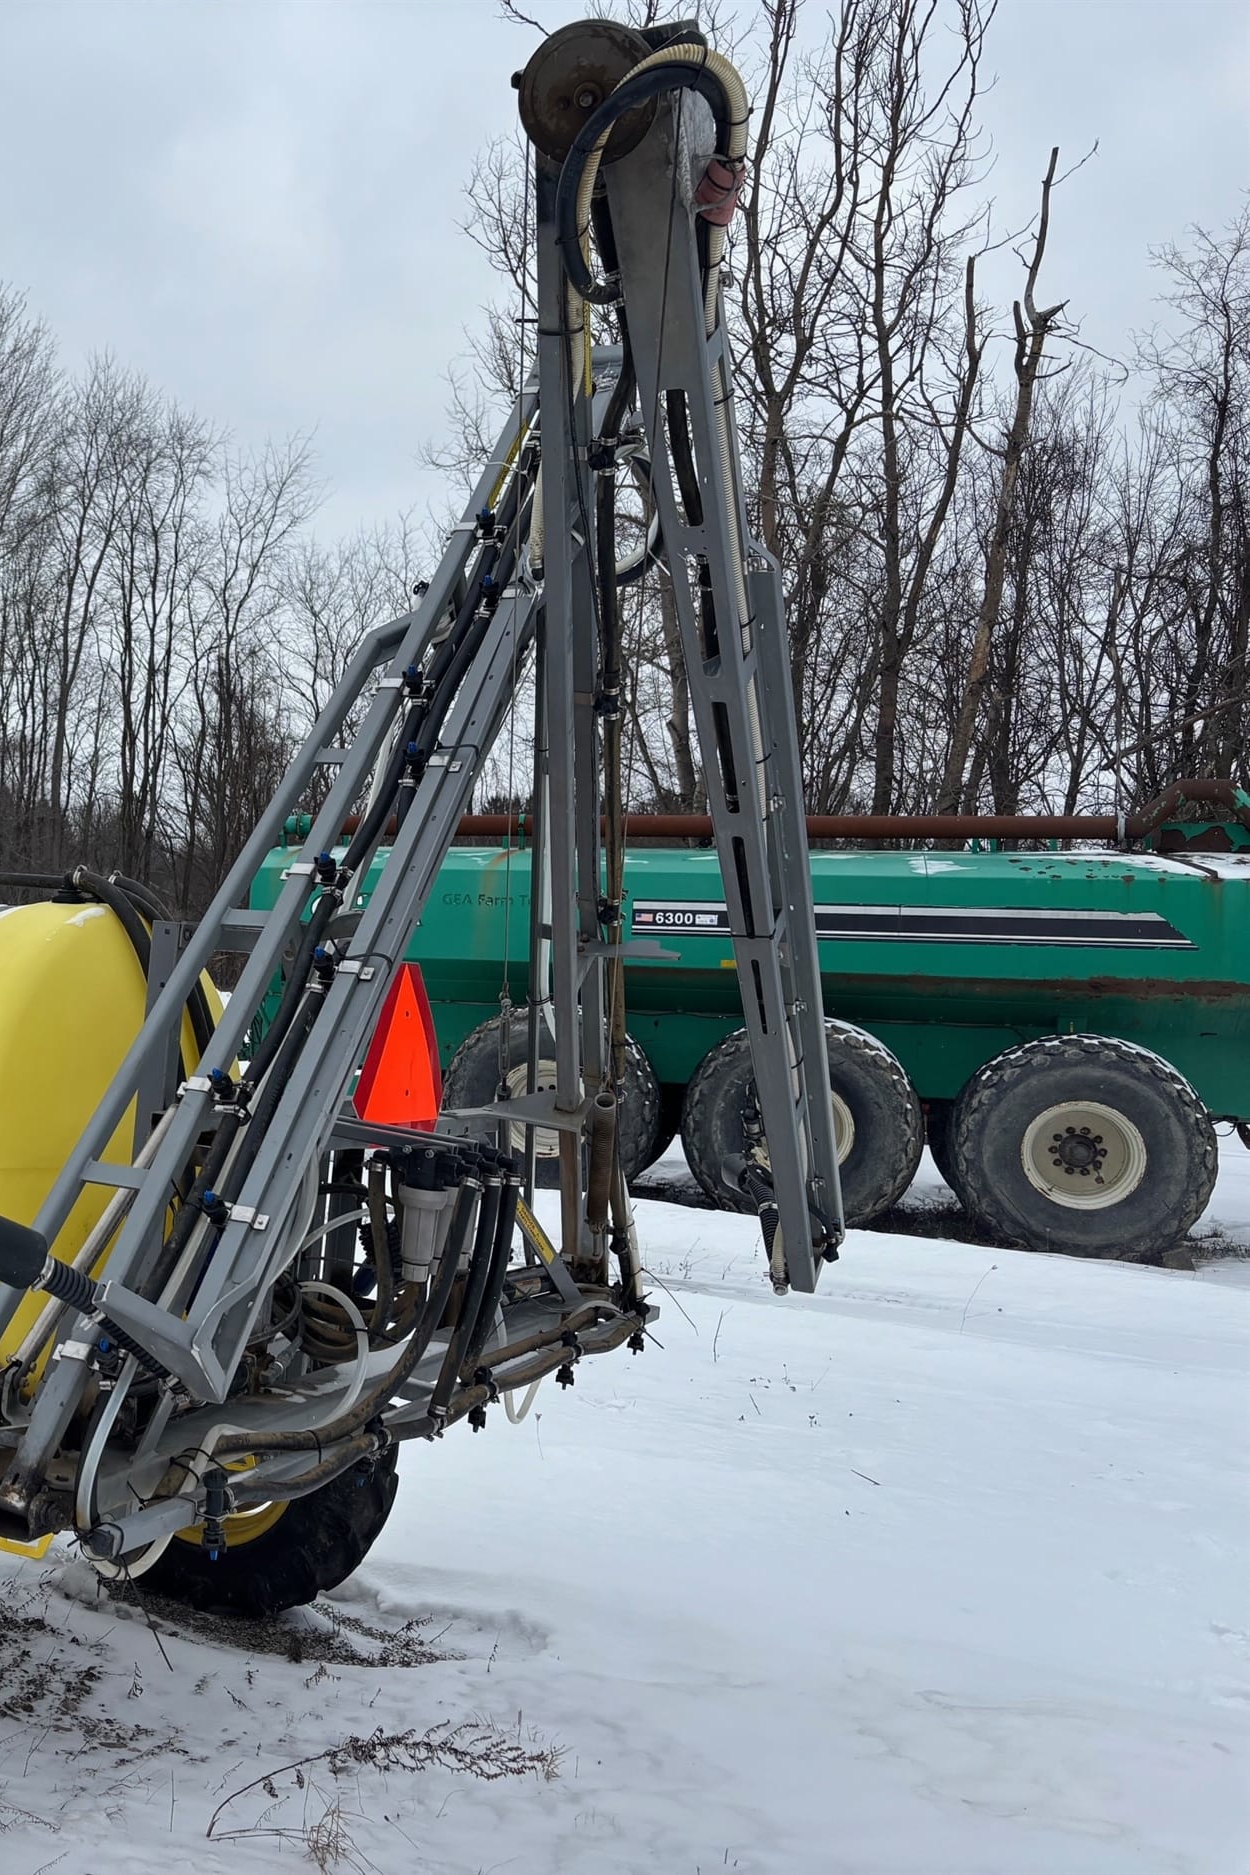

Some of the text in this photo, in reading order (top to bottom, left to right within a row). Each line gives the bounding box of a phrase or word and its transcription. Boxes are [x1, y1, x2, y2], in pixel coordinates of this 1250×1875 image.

[442, 893, 472, 905] GEA
[477, 893, 513, 906] Farm
[655, 912, 693, 924] 6300
